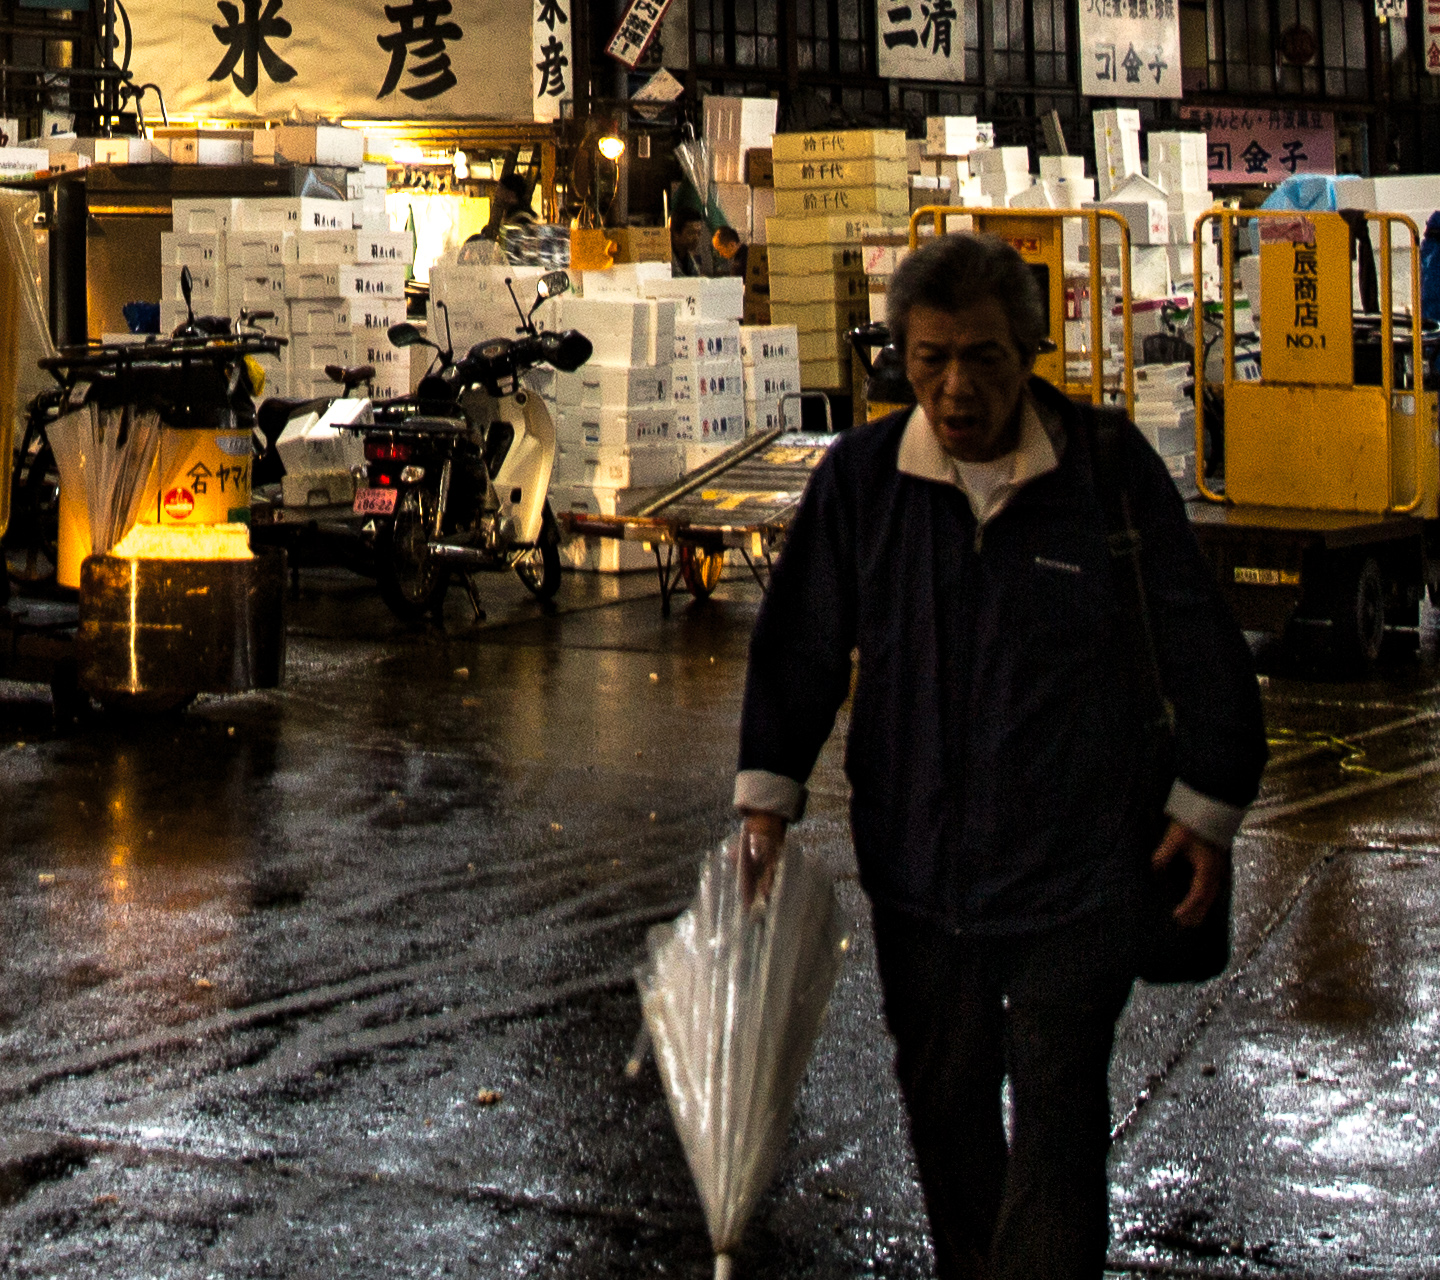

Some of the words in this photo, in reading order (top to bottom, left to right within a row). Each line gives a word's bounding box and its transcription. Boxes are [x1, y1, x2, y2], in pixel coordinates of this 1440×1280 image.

[1121, 41, 1167, 84] 金子
[1241, 141, 1308, 173] 金子
[1286, 334, 1326, 348] NO.1
